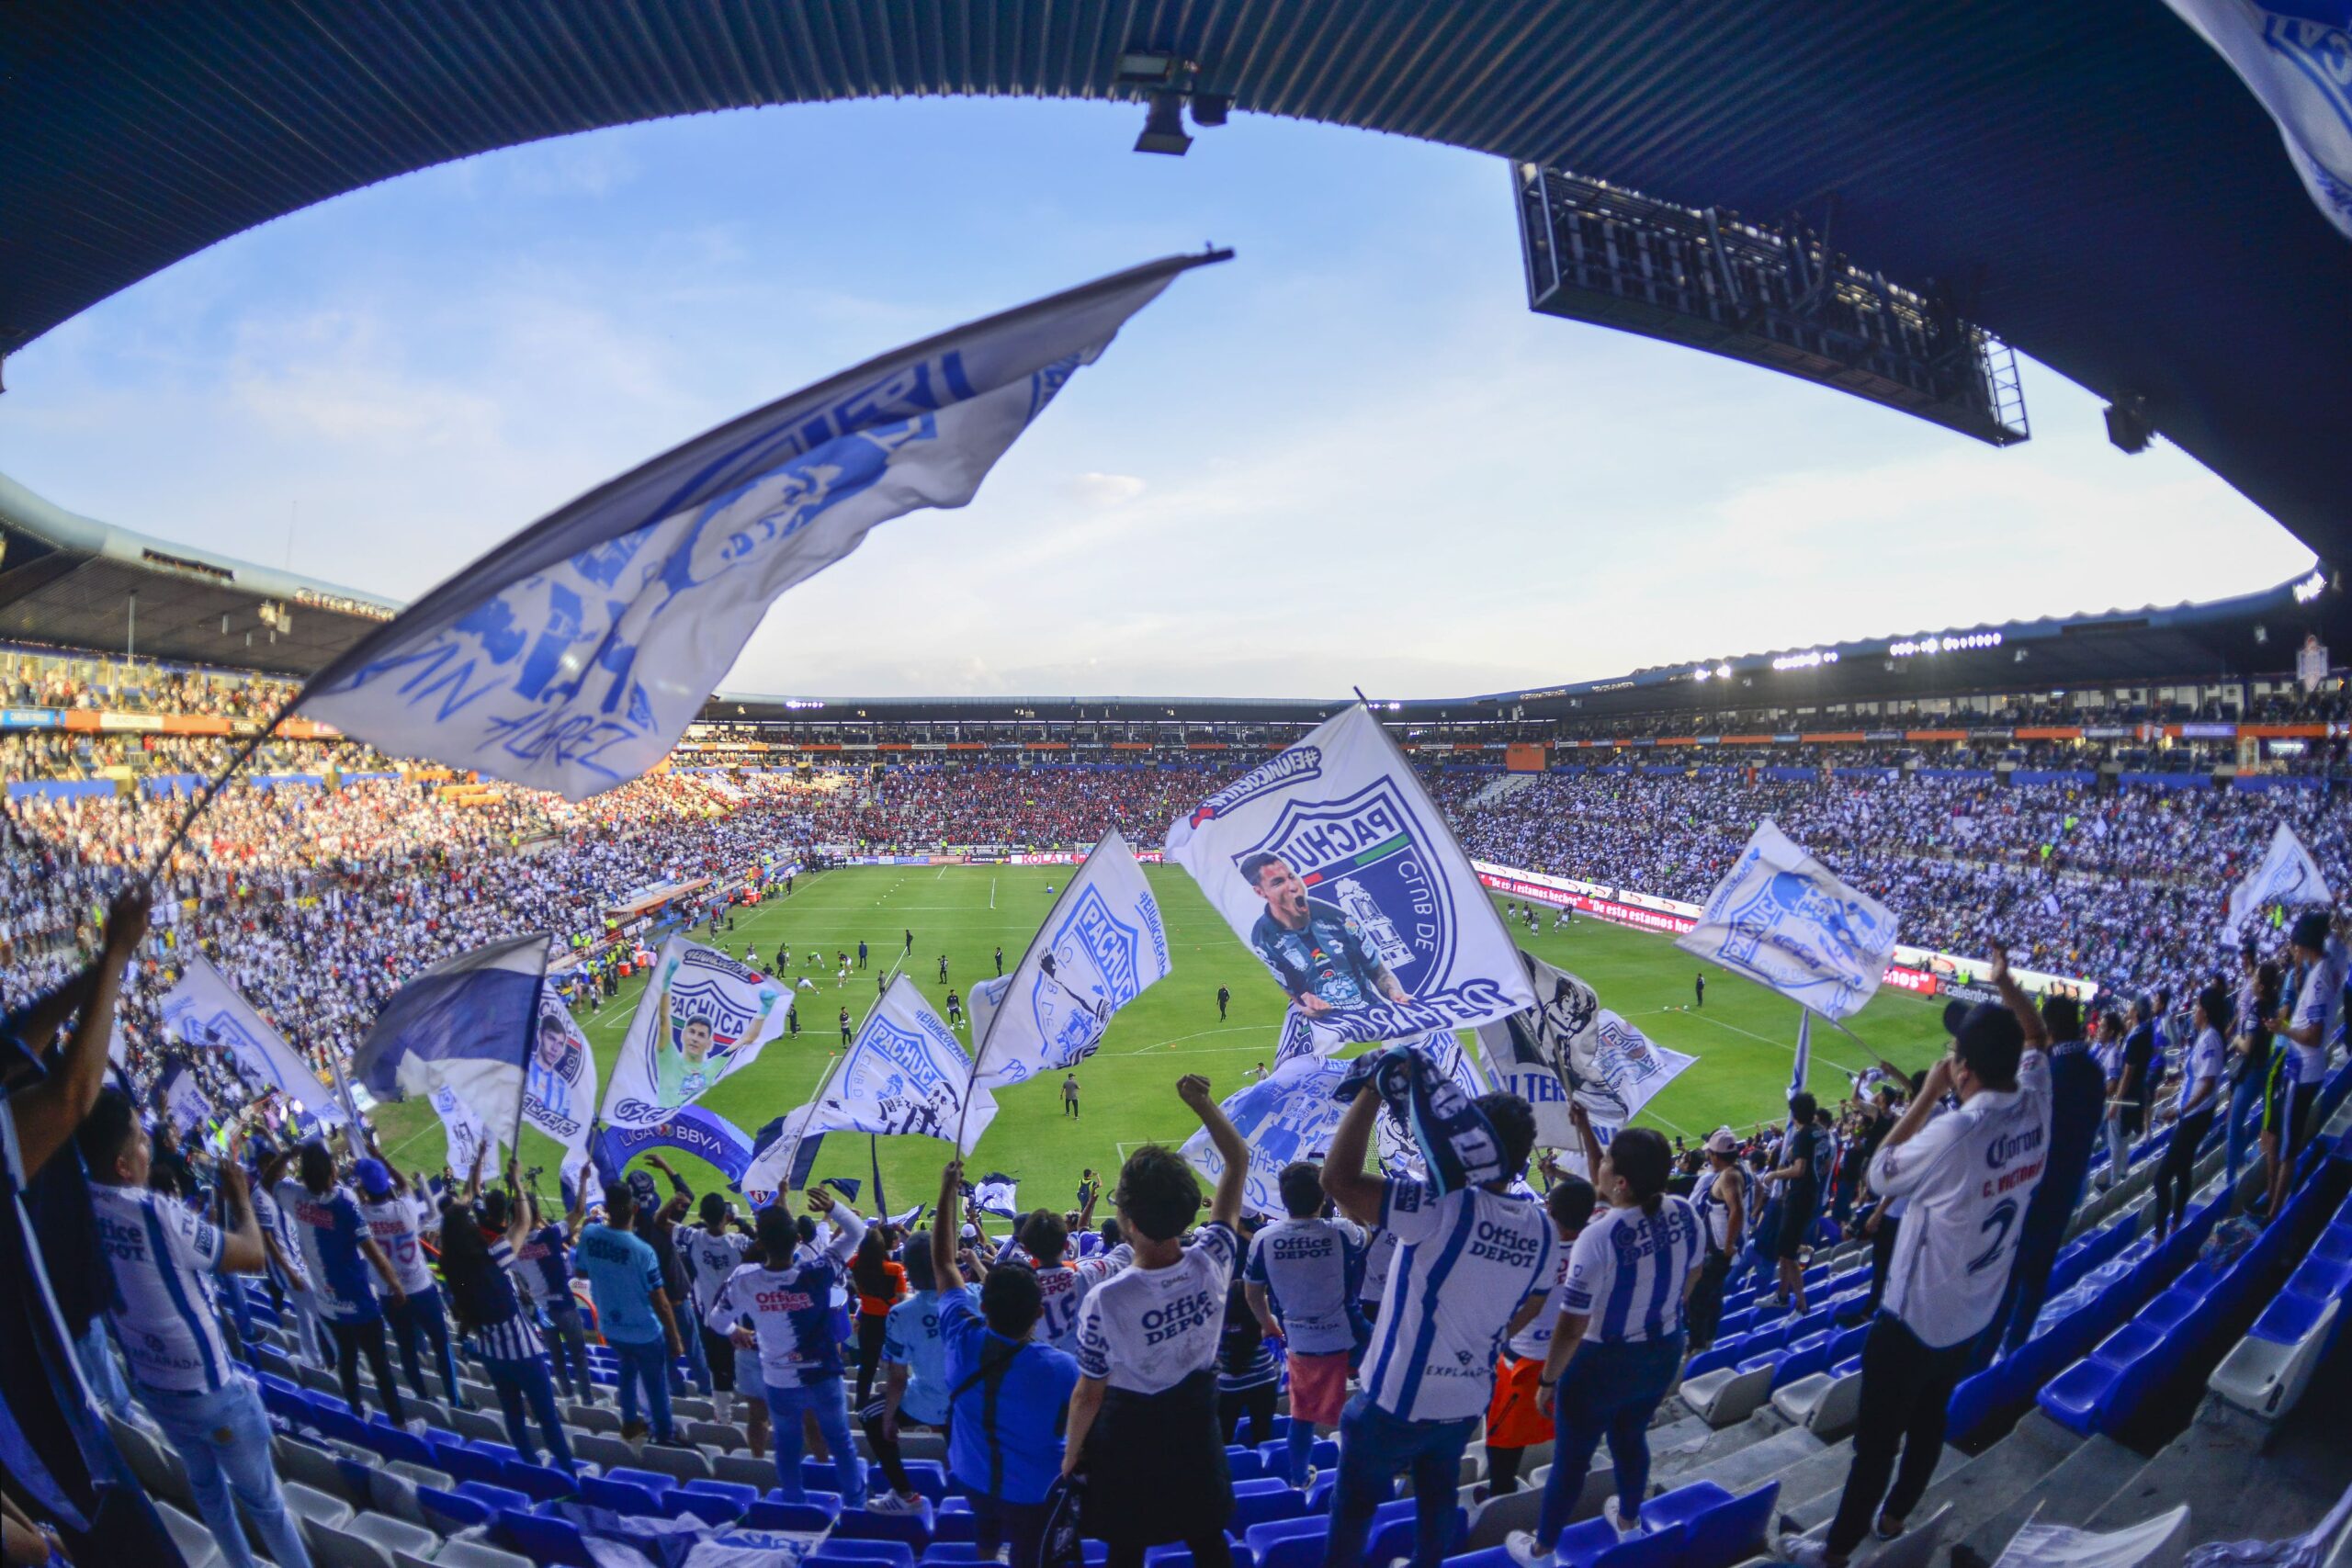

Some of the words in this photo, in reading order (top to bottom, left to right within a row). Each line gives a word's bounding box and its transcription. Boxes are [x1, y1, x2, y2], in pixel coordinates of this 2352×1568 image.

[1606, 905, 1628, 919] esto
[1629, 909, 1673, 930] estamos
[1082, 903, 1134, 1010] PACHUC
[619, 1129, 655, 1147] LIGA
[676, 1125, 722, 1155] BBVA
[1985, 1122, 2044, 1170] Coron
[1272, 1236, 1333, 1250] Office
[1477, 1220, 1539, 1254] Office
[1967, 1197, 2018, 1277] 2
[1273, 1248, 1333, 1260] DEPOT
[1470, 1240, 1536, 1269] DEPOT
[754, 1290, 810, 1304] Office
[759, 1301, 815, 1313] DEPOT
[1145, 1303, 1215, 1346] DEPOT
